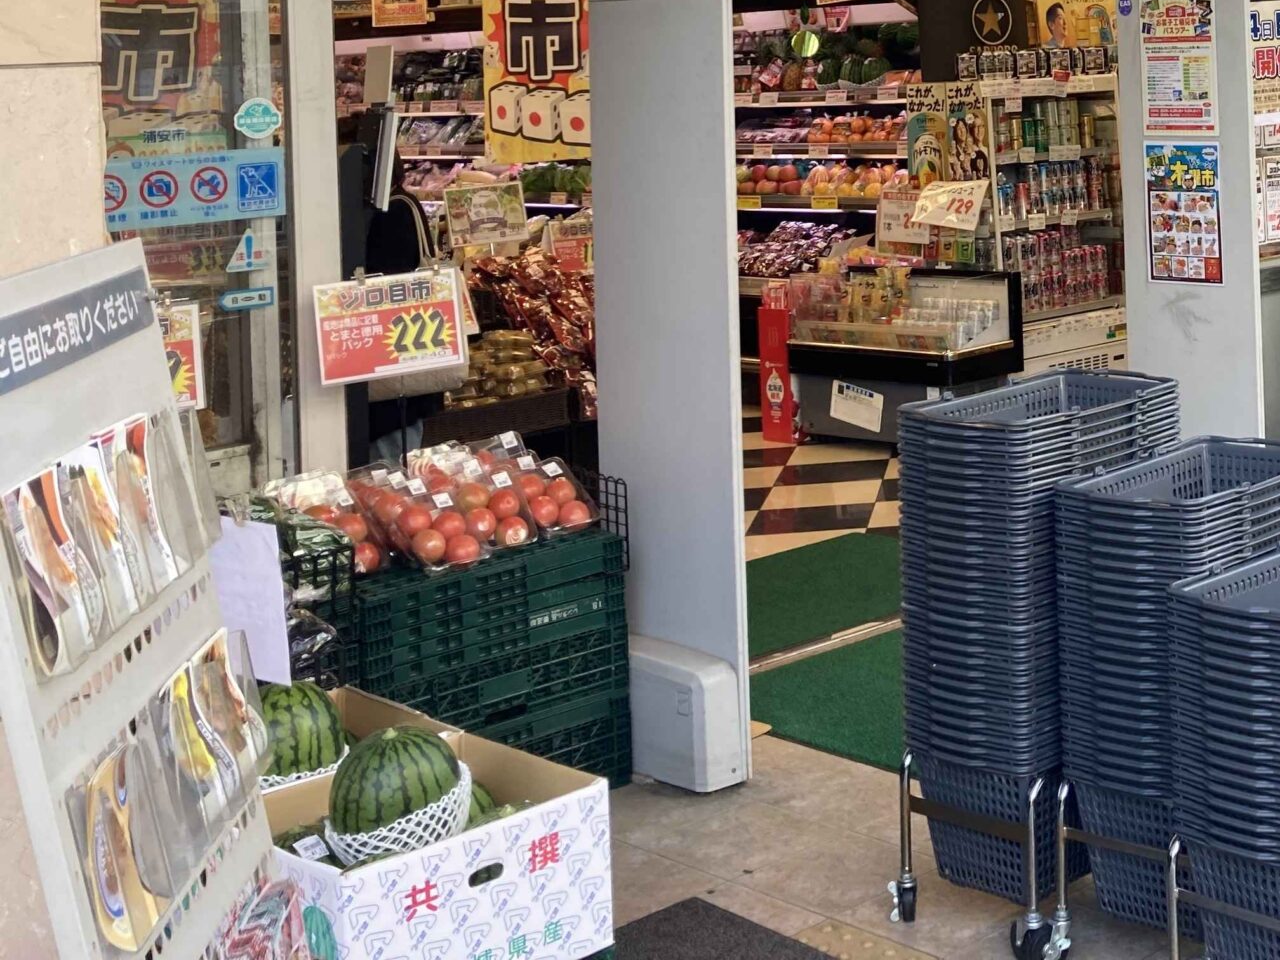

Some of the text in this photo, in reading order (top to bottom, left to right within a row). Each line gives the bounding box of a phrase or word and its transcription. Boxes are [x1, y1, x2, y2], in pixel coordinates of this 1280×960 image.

[908, 98, 945, 113] なかった!
[949, 97, 985, 113] なかった!
[946, 197, 974, 215] 129
[140, 210, 178, 220] 撮影禁止
[330, 325, 383, 341] とまと徳用
[391, 309, 446, 353] 222
[342, 338, 374, 351] パック
[404, 880, 440, 922] 共
